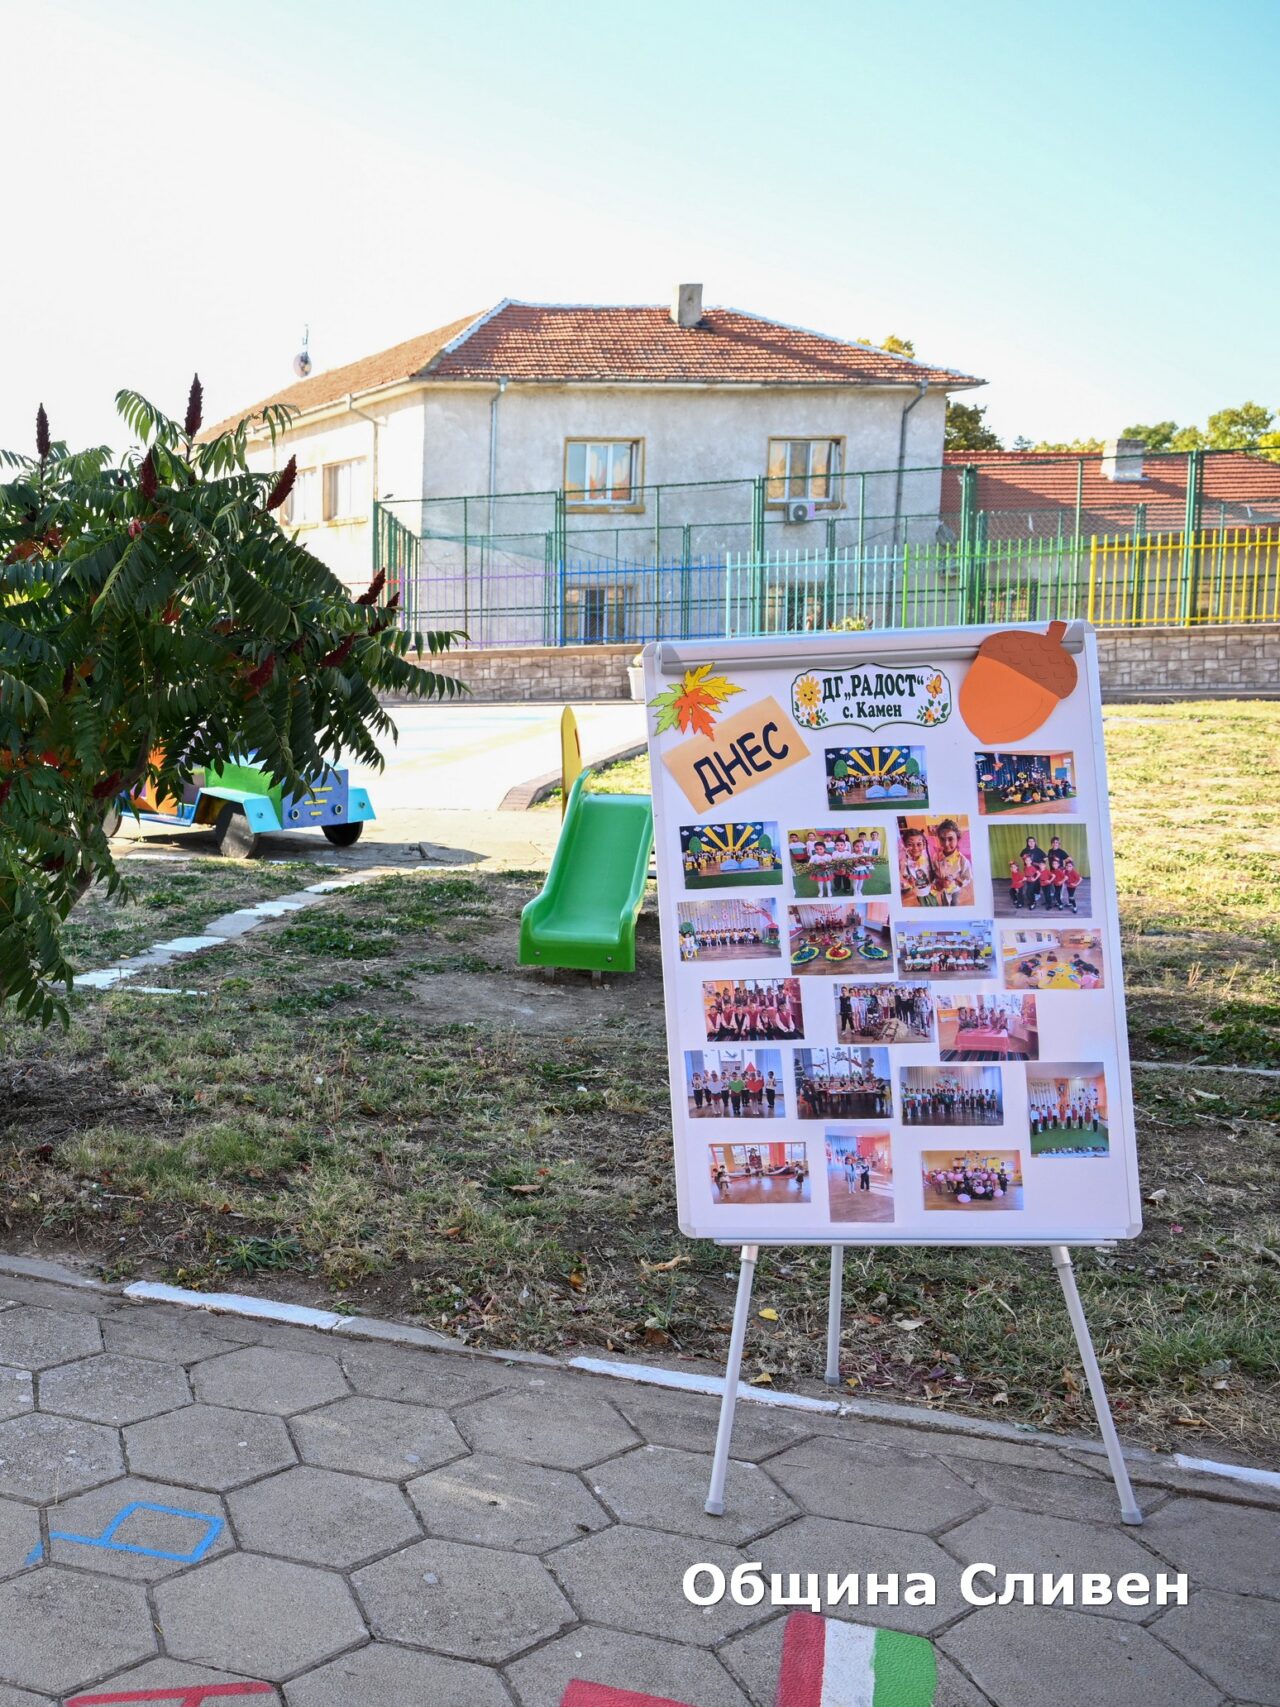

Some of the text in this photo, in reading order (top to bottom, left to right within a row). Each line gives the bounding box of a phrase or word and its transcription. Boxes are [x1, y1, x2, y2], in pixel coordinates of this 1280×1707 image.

[843, 702, 902, 719] с. Камен
[693, 722, 789, 804] ДНЕС
